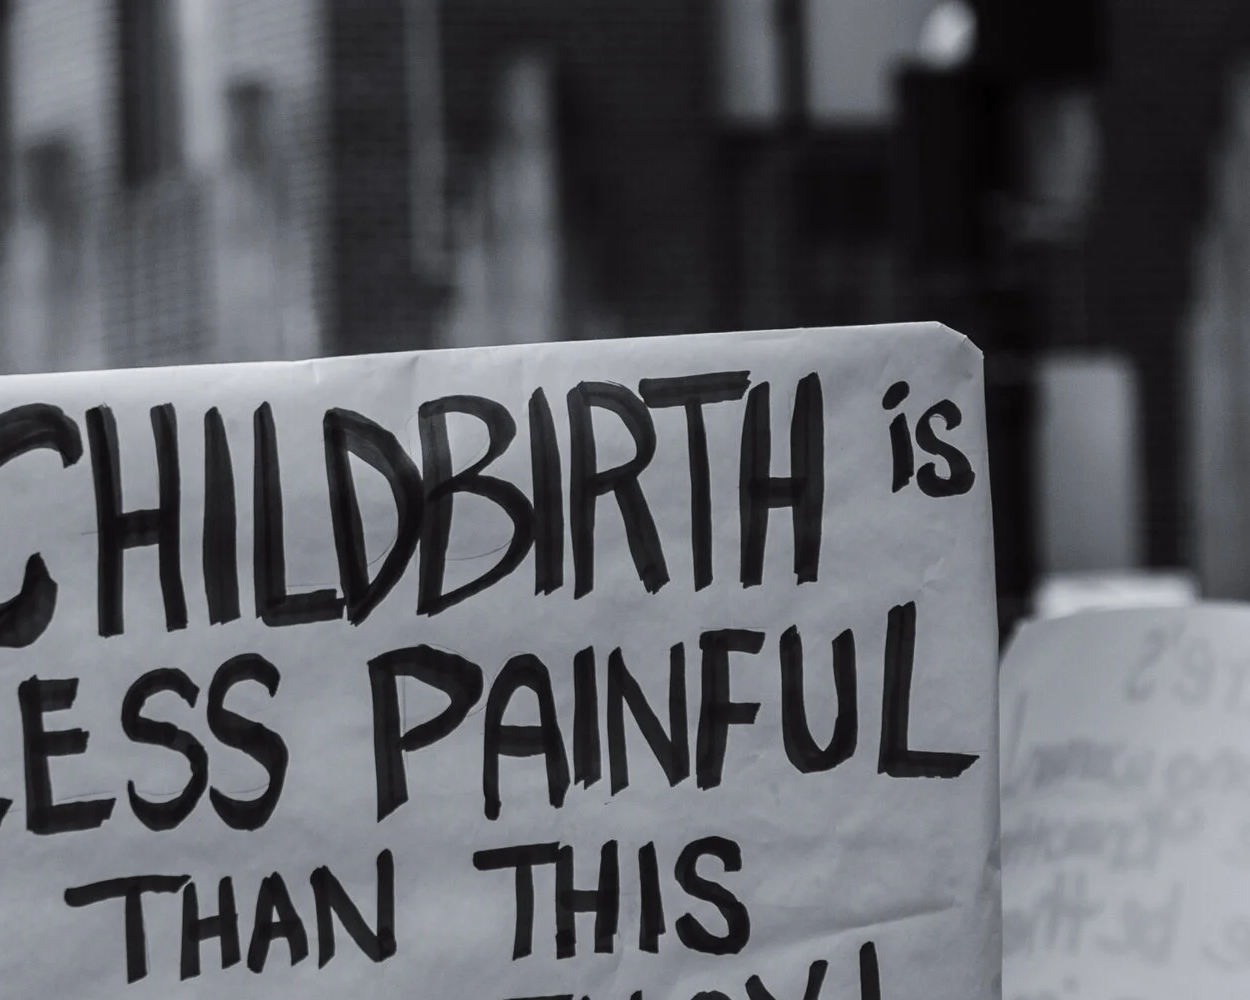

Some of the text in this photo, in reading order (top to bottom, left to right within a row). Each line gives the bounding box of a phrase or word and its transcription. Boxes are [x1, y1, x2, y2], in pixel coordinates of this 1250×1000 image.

[882, 380, 976, 498] is
[366, 600, 981, 823] PAINFUL
[63, 835, 751, 985] THAN THIS
